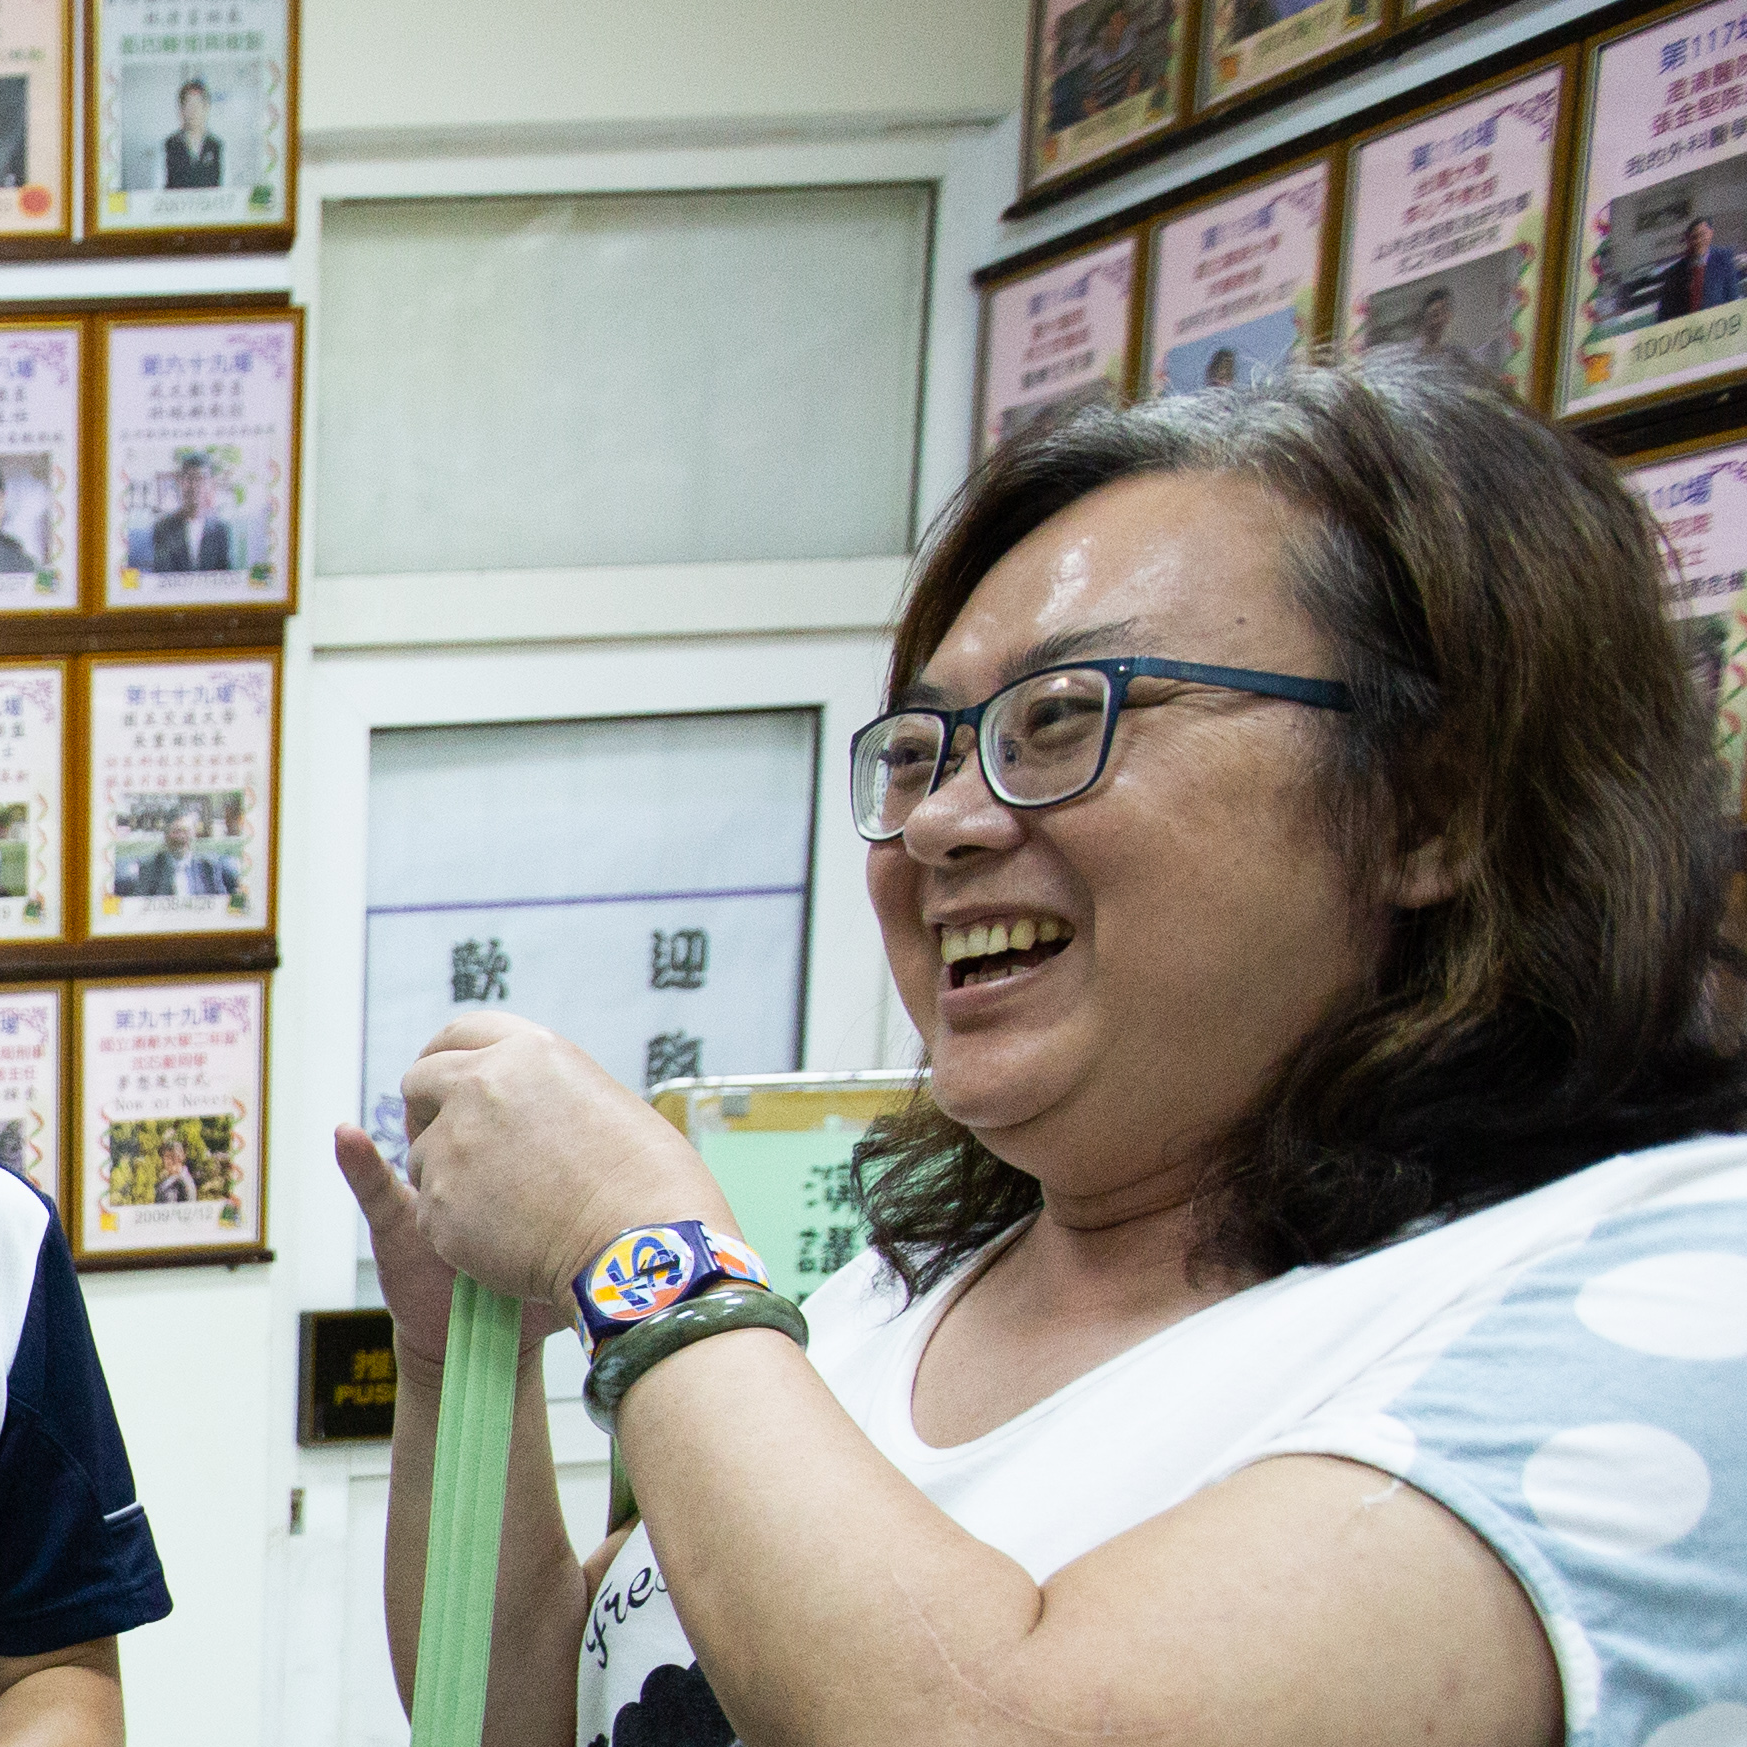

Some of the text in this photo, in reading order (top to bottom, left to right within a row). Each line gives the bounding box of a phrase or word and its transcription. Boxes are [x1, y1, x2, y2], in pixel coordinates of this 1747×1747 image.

[1649, 83, 1747, 139] 張金堅院
[126, 684, 235, 707] 第七十九場
[115, 1003, 221, 1030] 第九十九場
[332, 1383, 397, 1406] PUS
